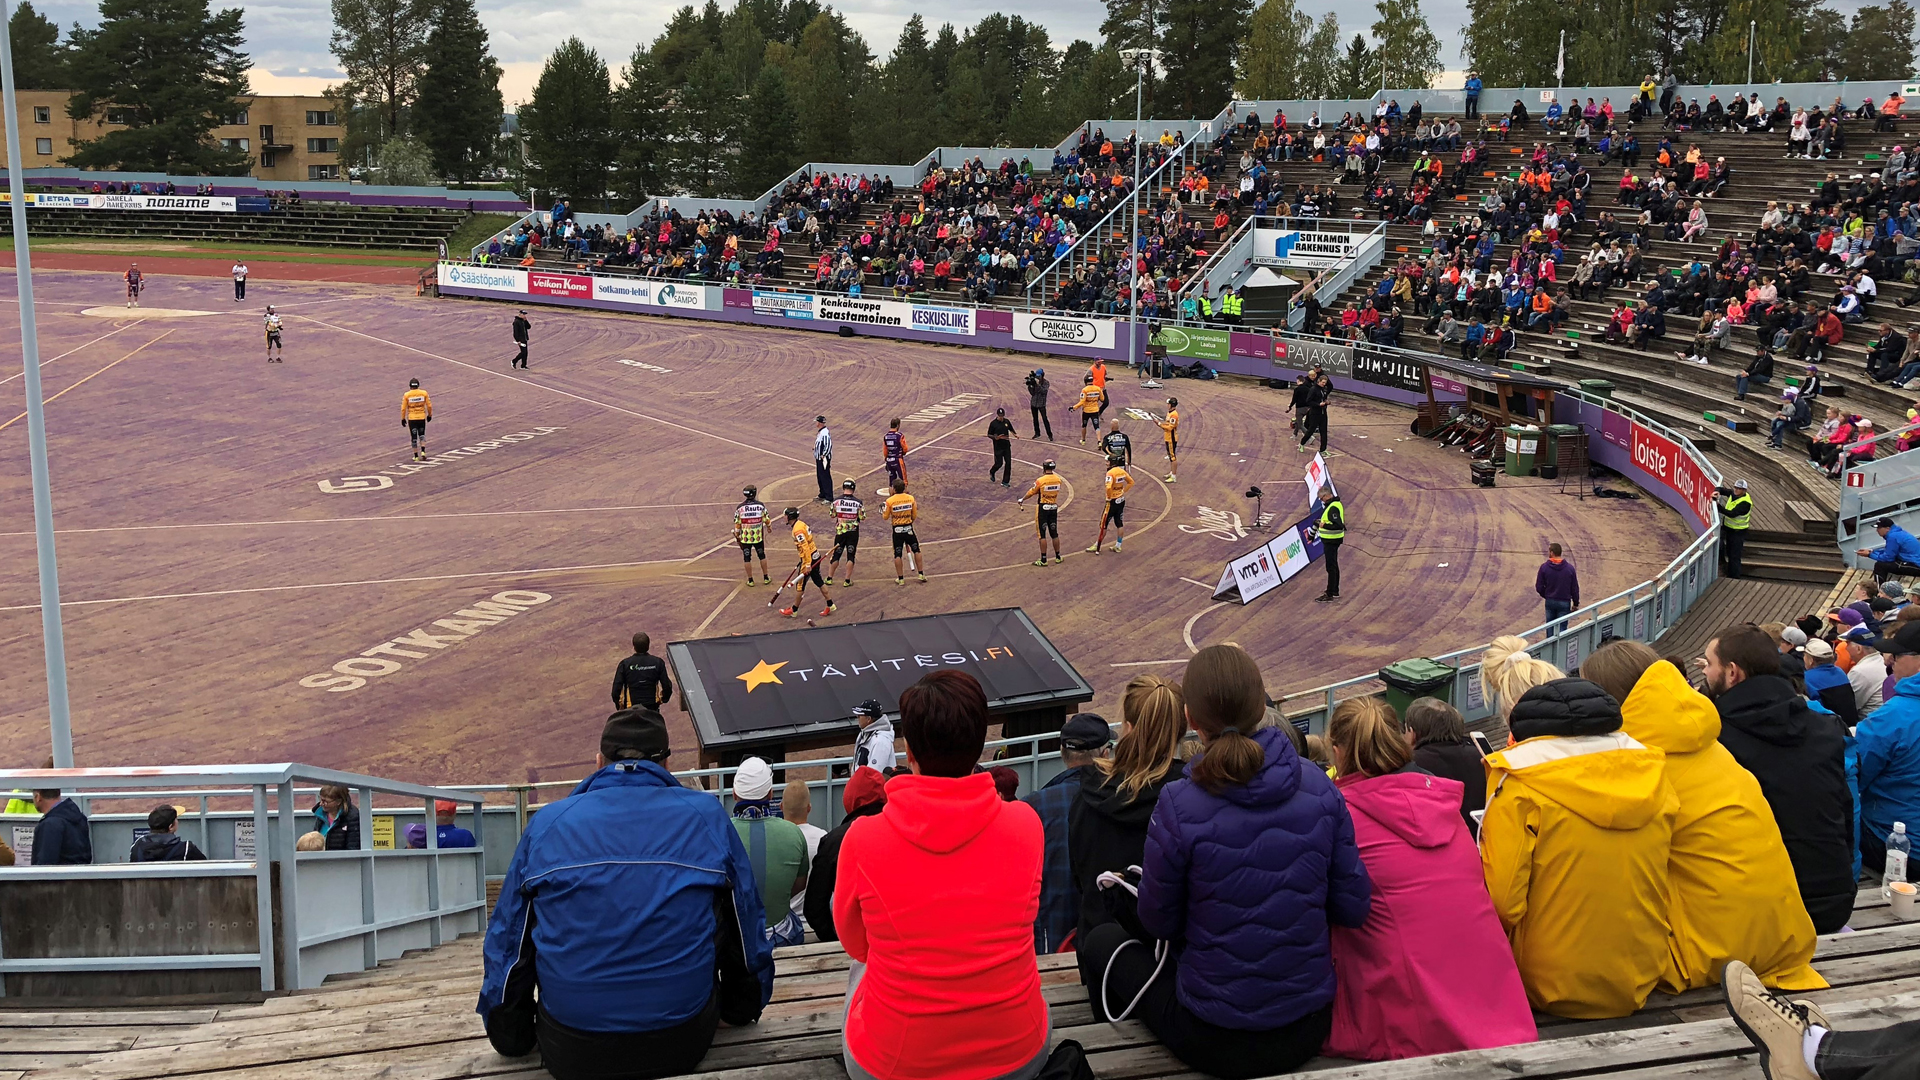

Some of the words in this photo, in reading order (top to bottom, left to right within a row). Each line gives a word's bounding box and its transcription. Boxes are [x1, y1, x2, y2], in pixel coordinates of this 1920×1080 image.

[146, 198, 210, 208] noname
[1300, 233, 1350, 244] SOTKAMON
[1295, 243, 1341, 253] RAKENNUS
[461, 271, 515, 288] Säästöpankki
[532, 276, 562, 289] Veikon
[563, 277, 588, 292] Kone
[598, 284, 649, 297] Sotkamo-lehti
[674, 295, 698, 305] SAMPO
[760, 297, 796, 309] RAUTAKAUPPA
[797, 301, 813, 311] LEHTO
[821, 297, 881, 312] Kenkäkauppa
[819, 307, 901, 326] Saastamoinen
[912, 309, 969, 329] KESKUSLIIKE
[1041, 321, 1084, 338] PAIKALLIS
[1047, 330, 1076, 340] SÄHKÖ
[1287, 344, 1348, 367] PAJAKKA
[381, 425, 568, 476] LÄHITAPIOLA
[1634, 430, 1667, 478] loiste
[1673, 452, 1694, 504] loiste
[1275, 539, 1301, 568] SUBWAY
[1238, 561, 1259, 580] vmp
[298, 590, 552, 692] SOTKAMO
[788, 645, 1015, 682] TÄHTESI.FI
